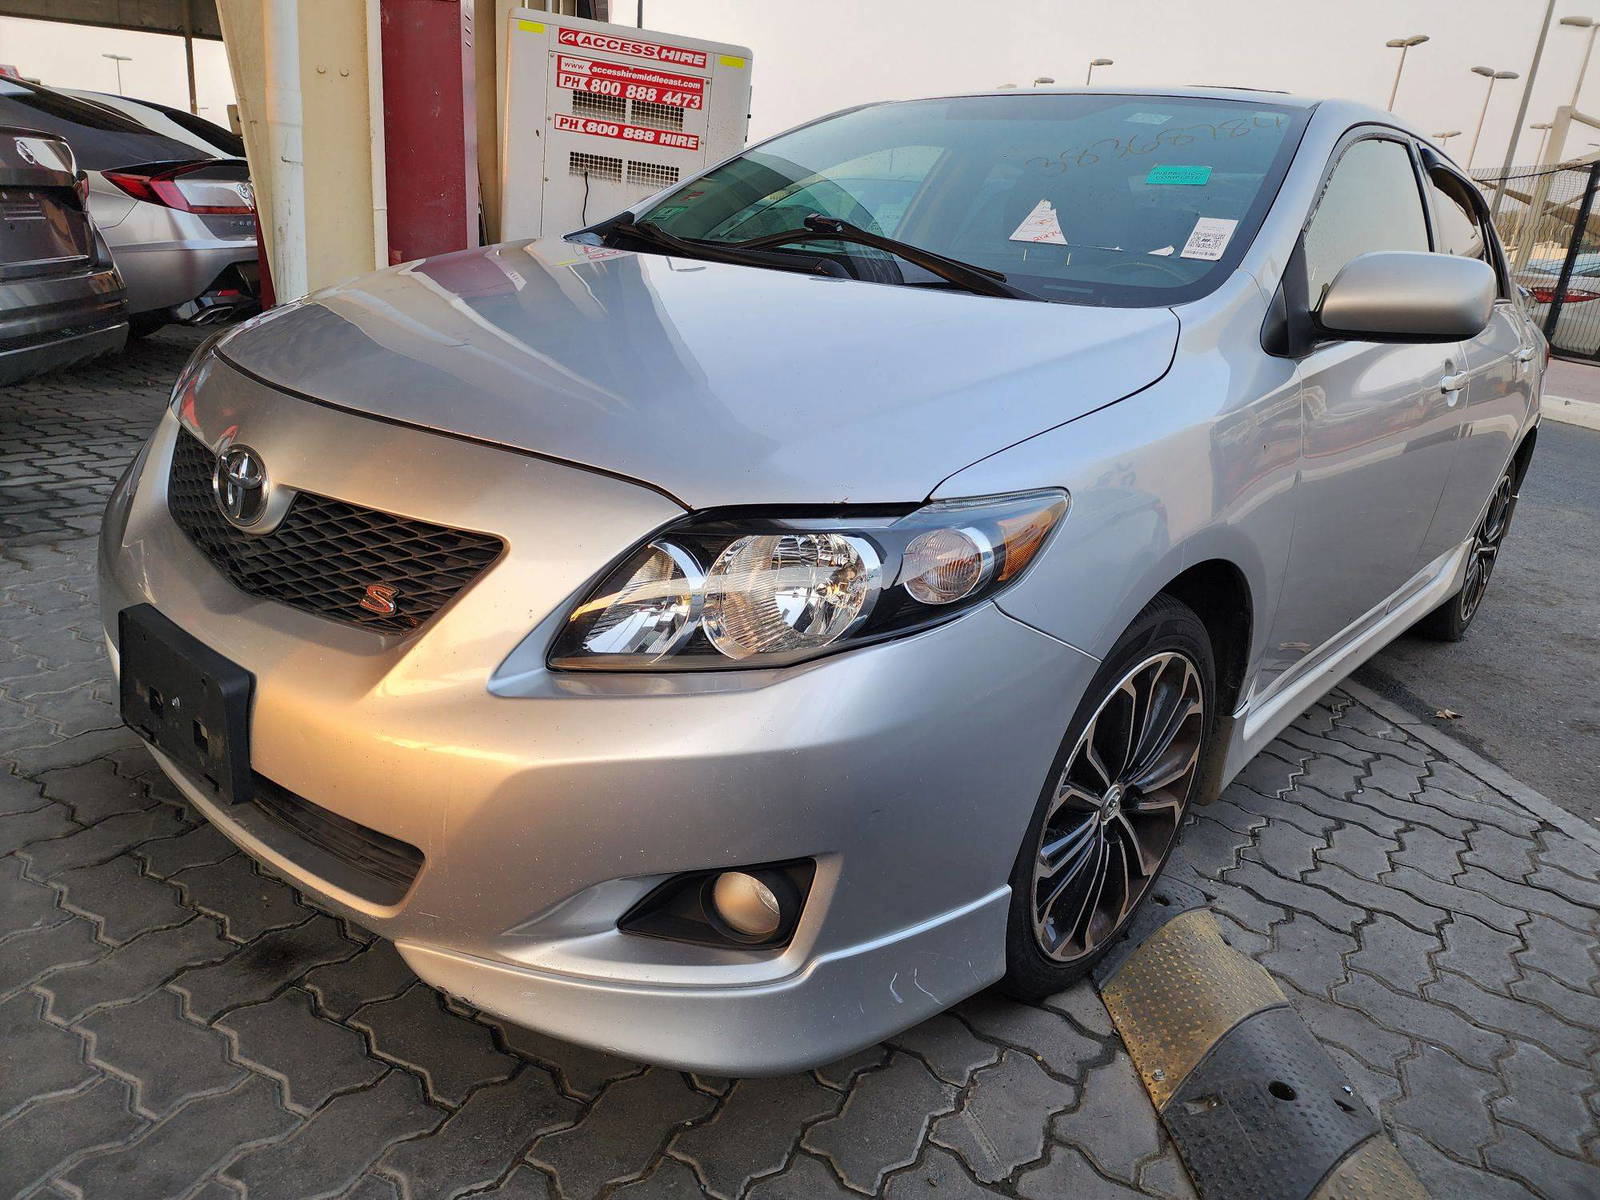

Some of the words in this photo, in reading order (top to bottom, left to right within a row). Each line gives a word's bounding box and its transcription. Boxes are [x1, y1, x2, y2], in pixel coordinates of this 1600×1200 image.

[581, 36, 656, 56] ACCESS
[661, 50, 705, 65] HIRE
[563, 76, 580, 87] PH
[590, 79, 621, 96] 800
[626, 85, 657, 101] 888
[662, 92, 701, 108] 4473
[591, 67, 701, 89] accesshiremiddleeast.com
[559, 118, 579, 129] PH
[586, 122, 619, 136] 800
[623, 128, 656, 141] 888
[659, 134, 698, 148] HIRE
[360, 583, 398, 615] S
